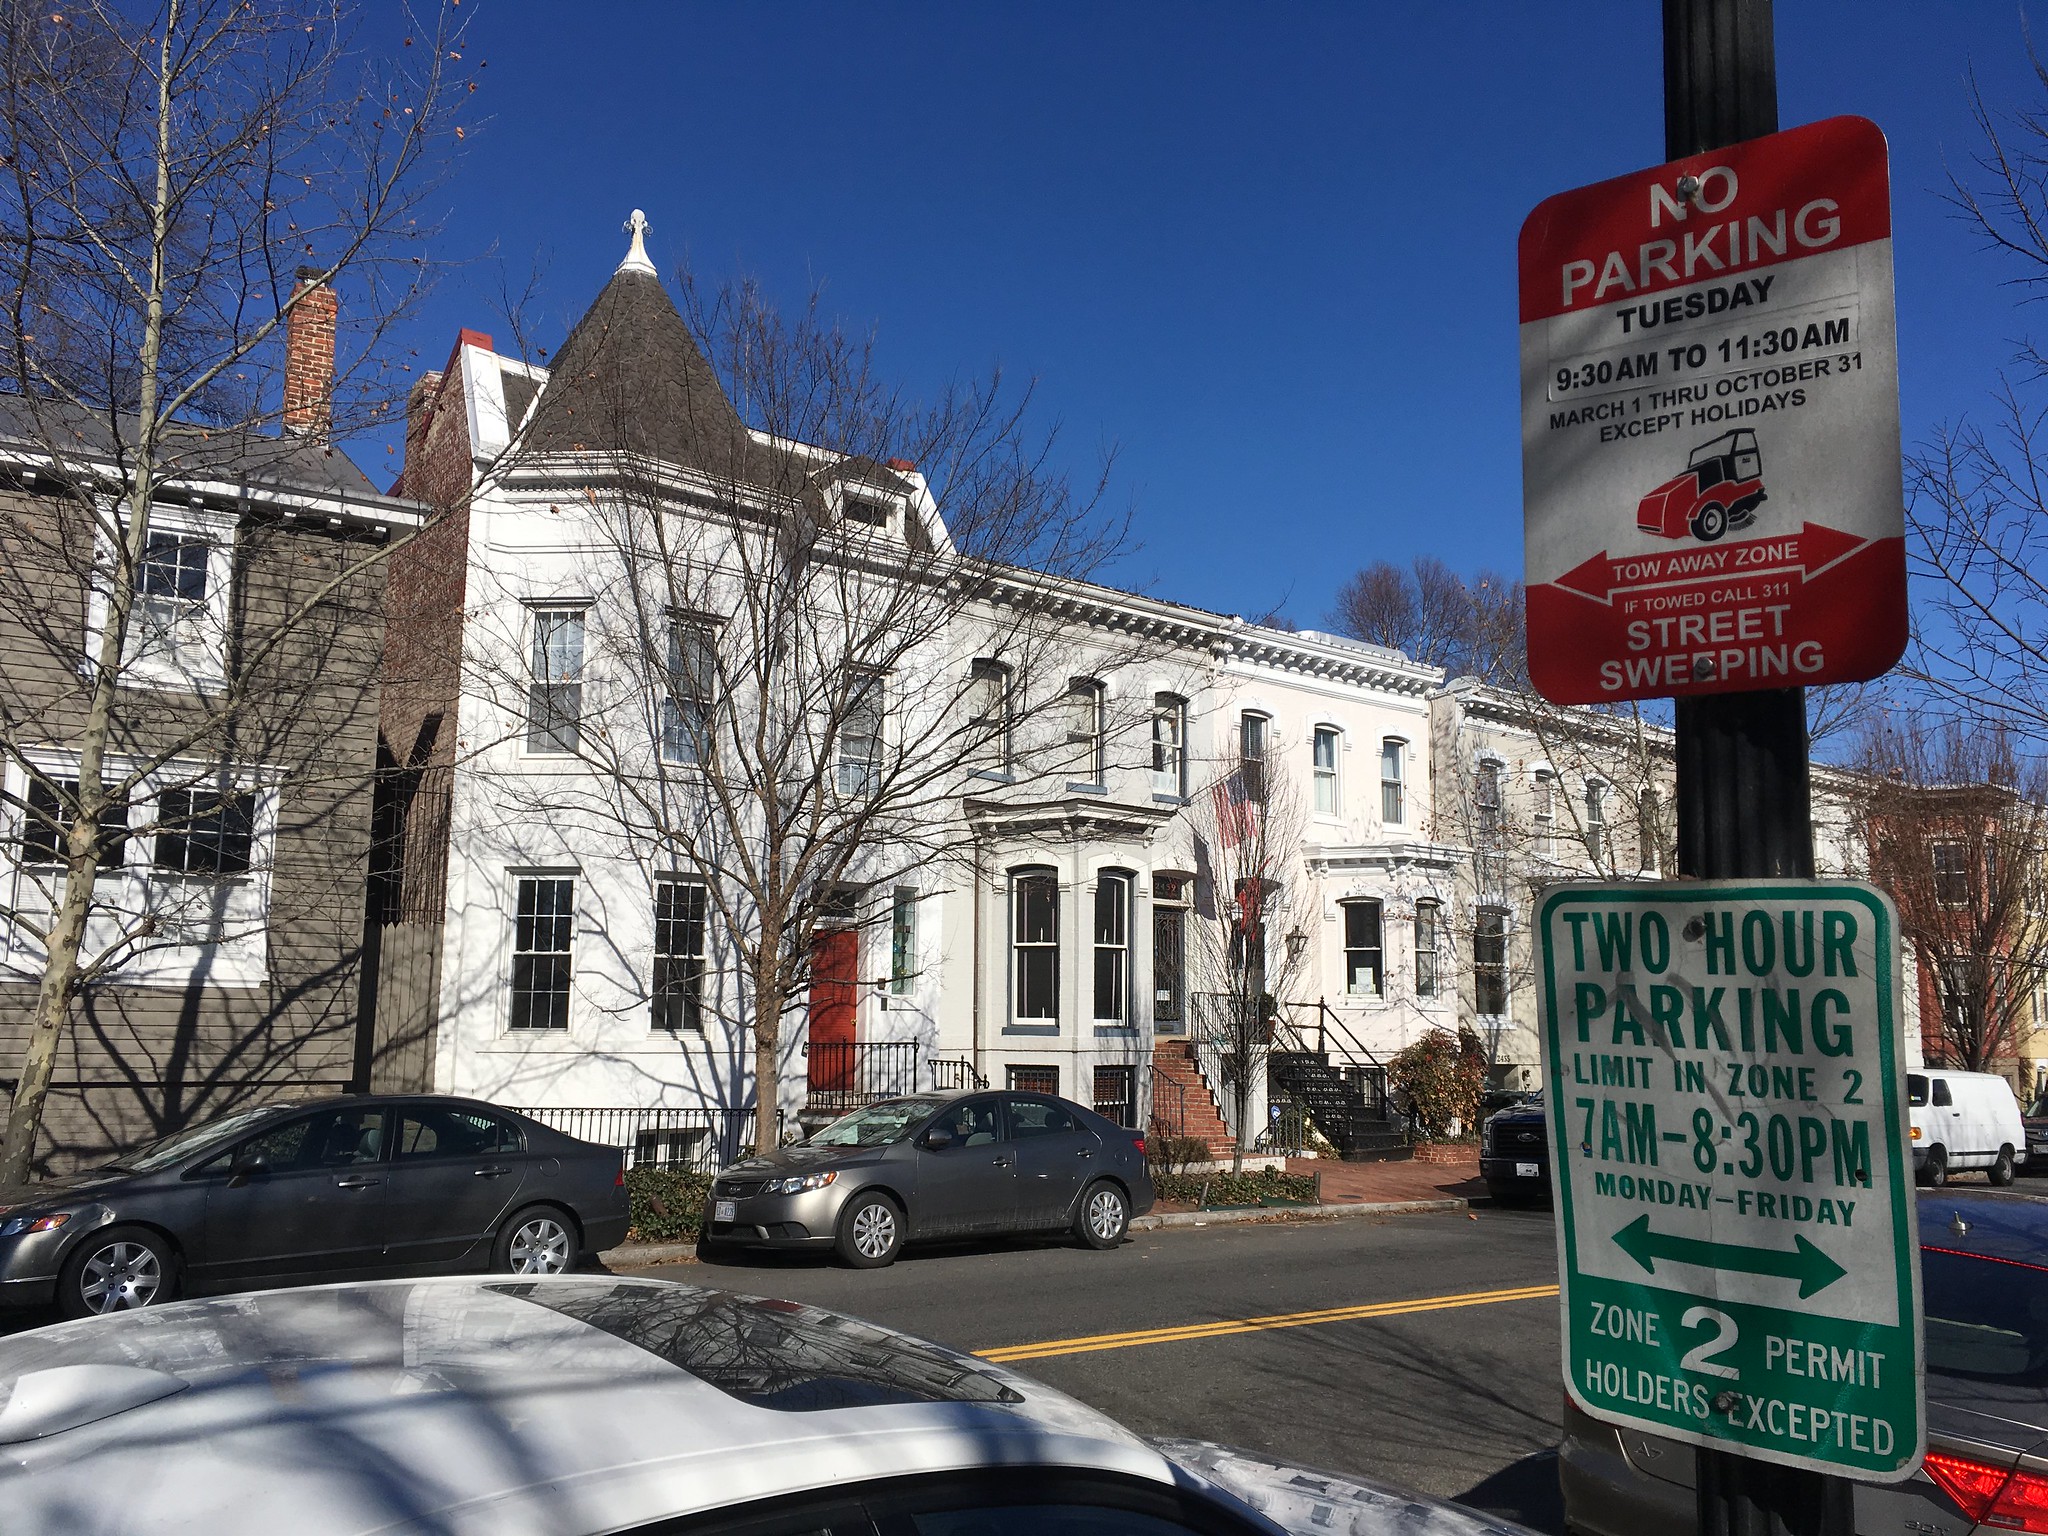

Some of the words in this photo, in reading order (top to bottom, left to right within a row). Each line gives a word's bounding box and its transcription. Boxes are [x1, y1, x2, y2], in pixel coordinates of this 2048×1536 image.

[1650, 166, 1738, 228] NO
[1562, 198, 1842, 307] PARKING
[1616, 275, 1776, 333] TUESDAY
[1668, 344, 1707, 371] TO
[1550, 400, 1625, 429] MARCH
[1632, 397, 1641, 413] 1
[1649, 383, 1708, 409] THRU
[1716, 359, 1831, 397] OCTOBER
[1838, 352, 1862, 373] 31
[1600, 411, 1684, 442] EXCEPT
[1691, 389, 1807, 426] HOLIDAYS
[1613, 561, 1661, 581] TOW
[1667, 553, 1728, 573] AWAY
[1736, 541, 1799, 565] ZONE
[1625, 601, 1639, 613] IF
[1644, 592, 1706, 611] TOWED
[1711, 586, 1757, 604] CALL
[1763, 582, 1790, 598] 311
[1627, 604, 1791, 650] STREET
[1563, 911, 1670, 974] TWO
[1703, 910, 1860, 978] HOUR
[1575, 982, 1854, 1057] PARKING
[1575, 1053, 1653, 1089] LIMIT
[1674, 1061, 1706, 1093] IN
[1727, 1063, 1818, 1101] ZONE
[1843, 1069, 1864, 1105] 2
[1590, 1302, 1661, 1347] ZONE
[1680, 1306, 1740, 1381] 2
[1766, 1335, 1886, 1389] PERMIT
[1586, 1358, 1711, 1420] HOLDERS
[1727, 1390, 1895, 1456] EXCEPTED
